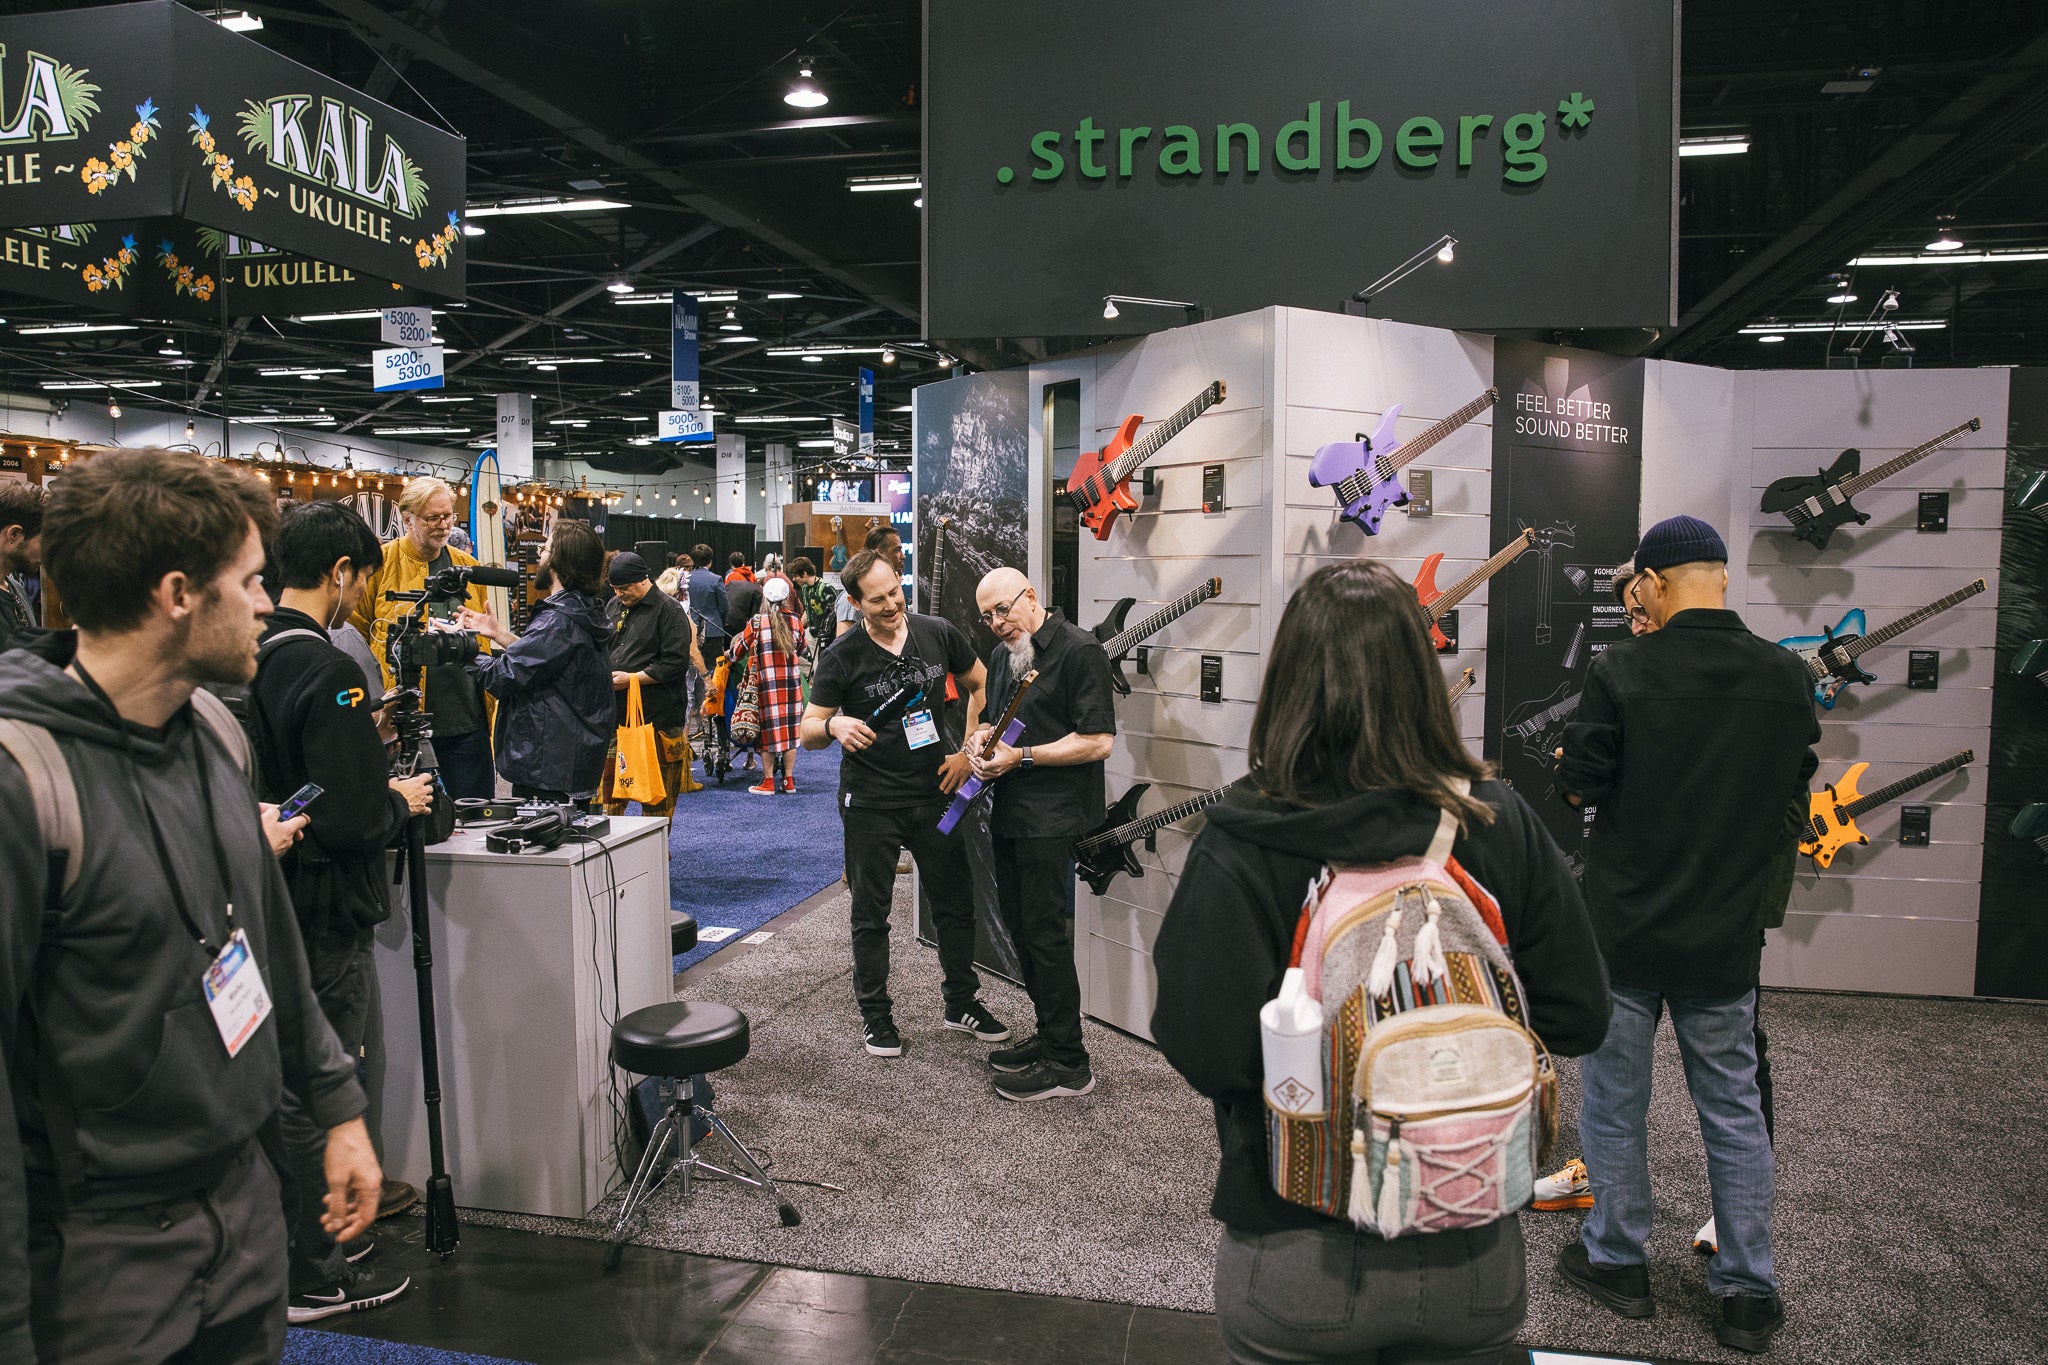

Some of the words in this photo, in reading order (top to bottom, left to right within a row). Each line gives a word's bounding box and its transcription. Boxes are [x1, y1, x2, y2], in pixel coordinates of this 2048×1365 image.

[0, 153, 41, 186] LE
[266, 94, 415, 220] KALA
[289, 183, 392, 244] UKULELE
[0, 236, 51, 271] ELE
[390, 311, 420, 326] 5300-
[675, 314, 698, 330] NAMM
[400, 327, 425, 341] 5200
[386, 351, 423, 369] 5200-
[399, 363, 431, 381] 5300
[668, 412, 698, 426] 5000-
[1516, 393, 1552, 414] FEEL
[1557, 397, 1611, 420] BETTER
[678, 422, 704, 434] 5100
[1515, 416, 1571, 438] SOUND
[1575, 422, 1629, 444] BETTER
[341, 491, 406, 543] ALA
[864, 664, 945, 698] THOANN
